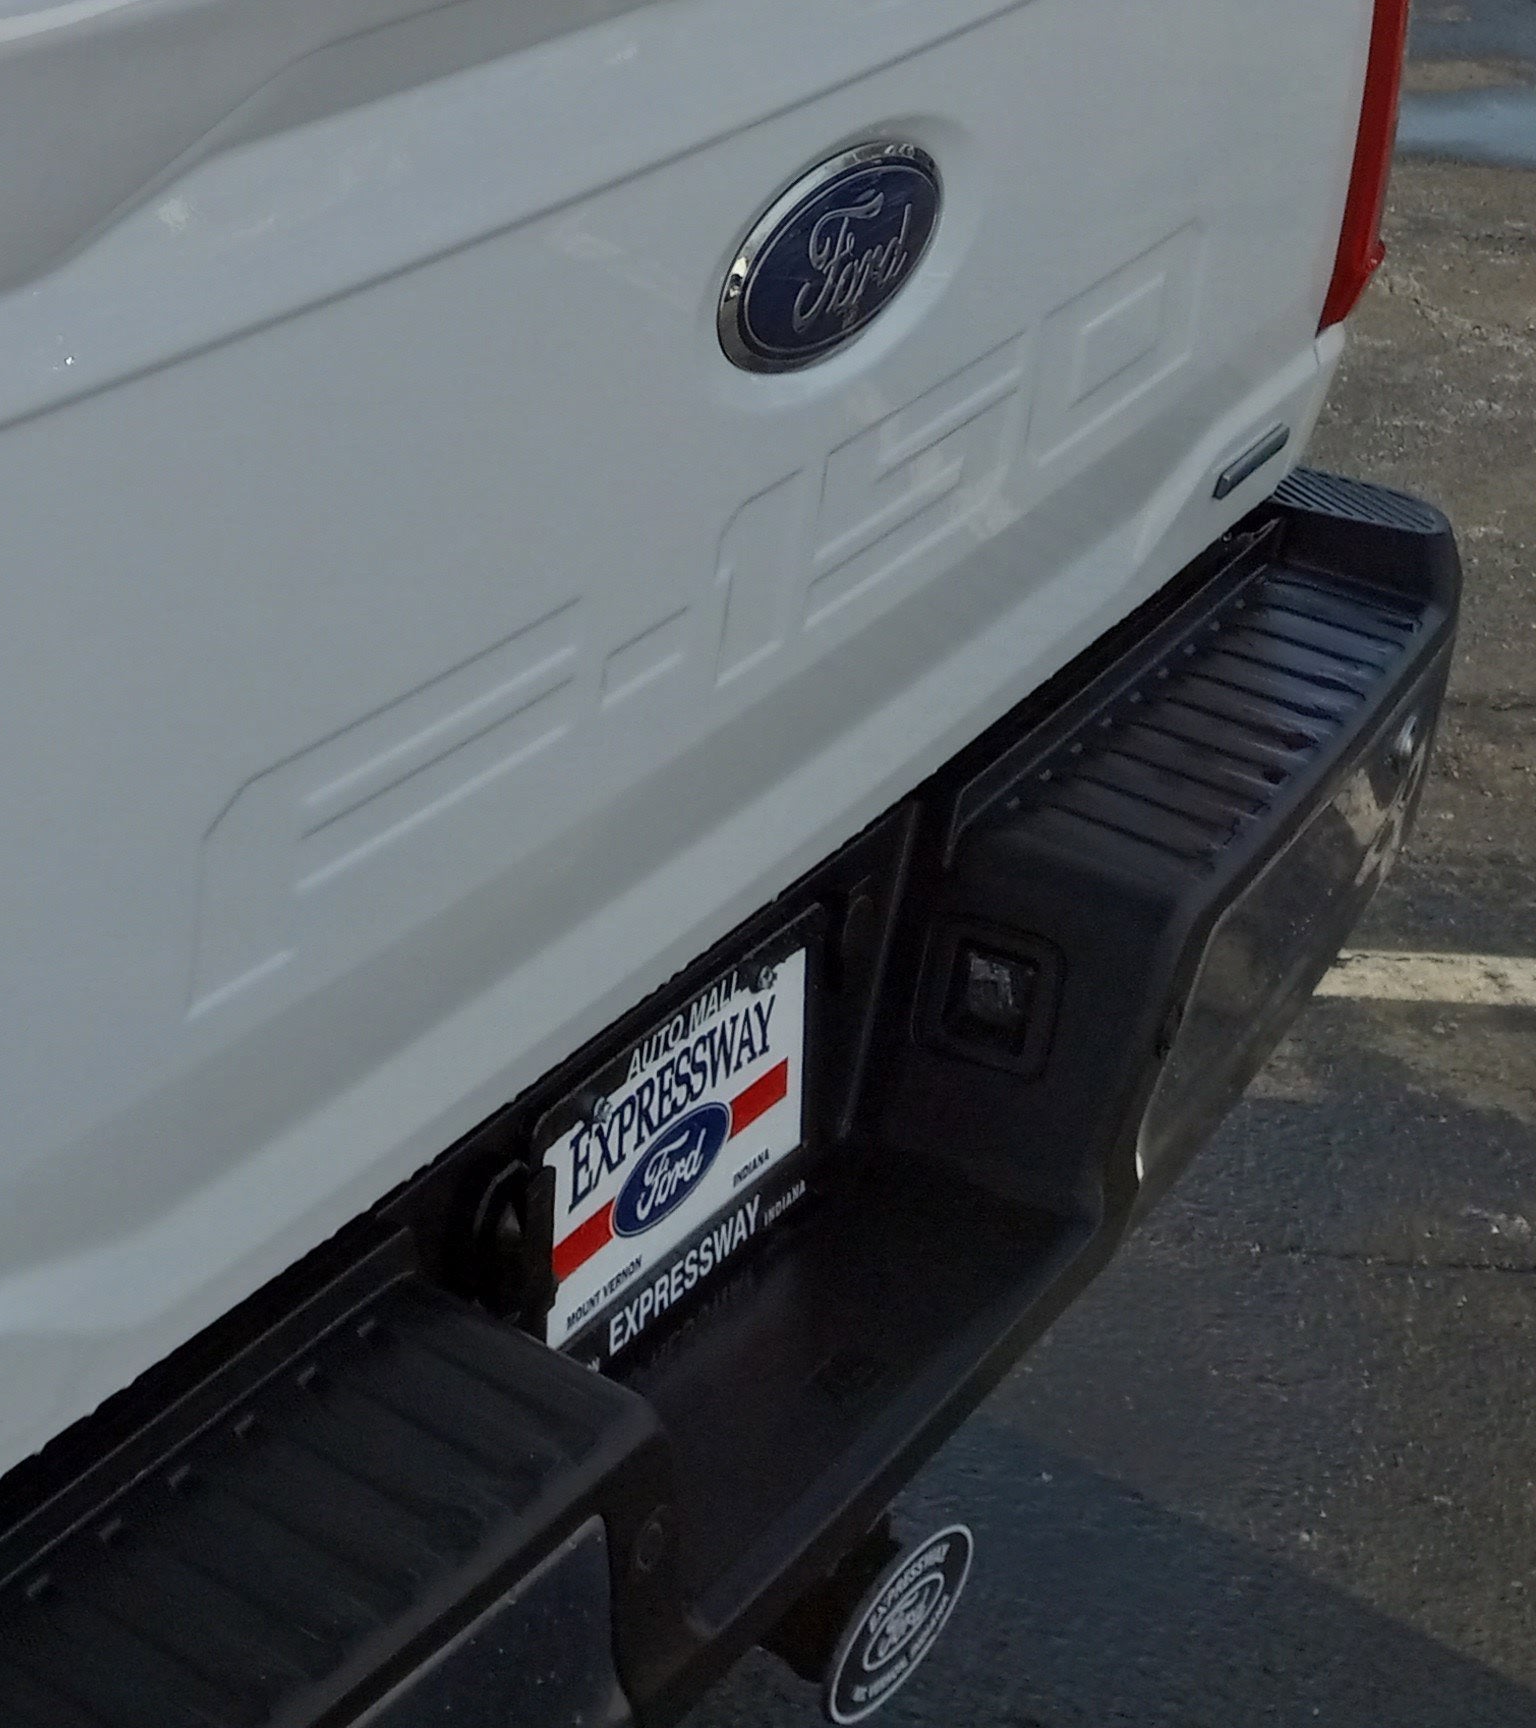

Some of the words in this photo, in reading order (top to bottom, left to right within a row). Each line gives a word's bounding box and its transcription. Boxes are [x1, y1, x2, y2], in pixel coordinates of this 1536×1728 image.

[794, 191, 912, 333] Ford
[630, 1014, 686, 1076] AUTO
[690, 971, 740, 1035] MALL
[567, 994, 776, 1214] EXPRESSWAY
[636, 1128, 705, 1221] Ford
[733, 1148, 770, 1188] INDIANA
[566, 1292, 601, 1331] MOUNT
[602, 1255, 643, 1299] VERNON
[609, 1194, 761, 1356] EXPRESSWAY
[764, 1179, 807, 1227] INDIANA
